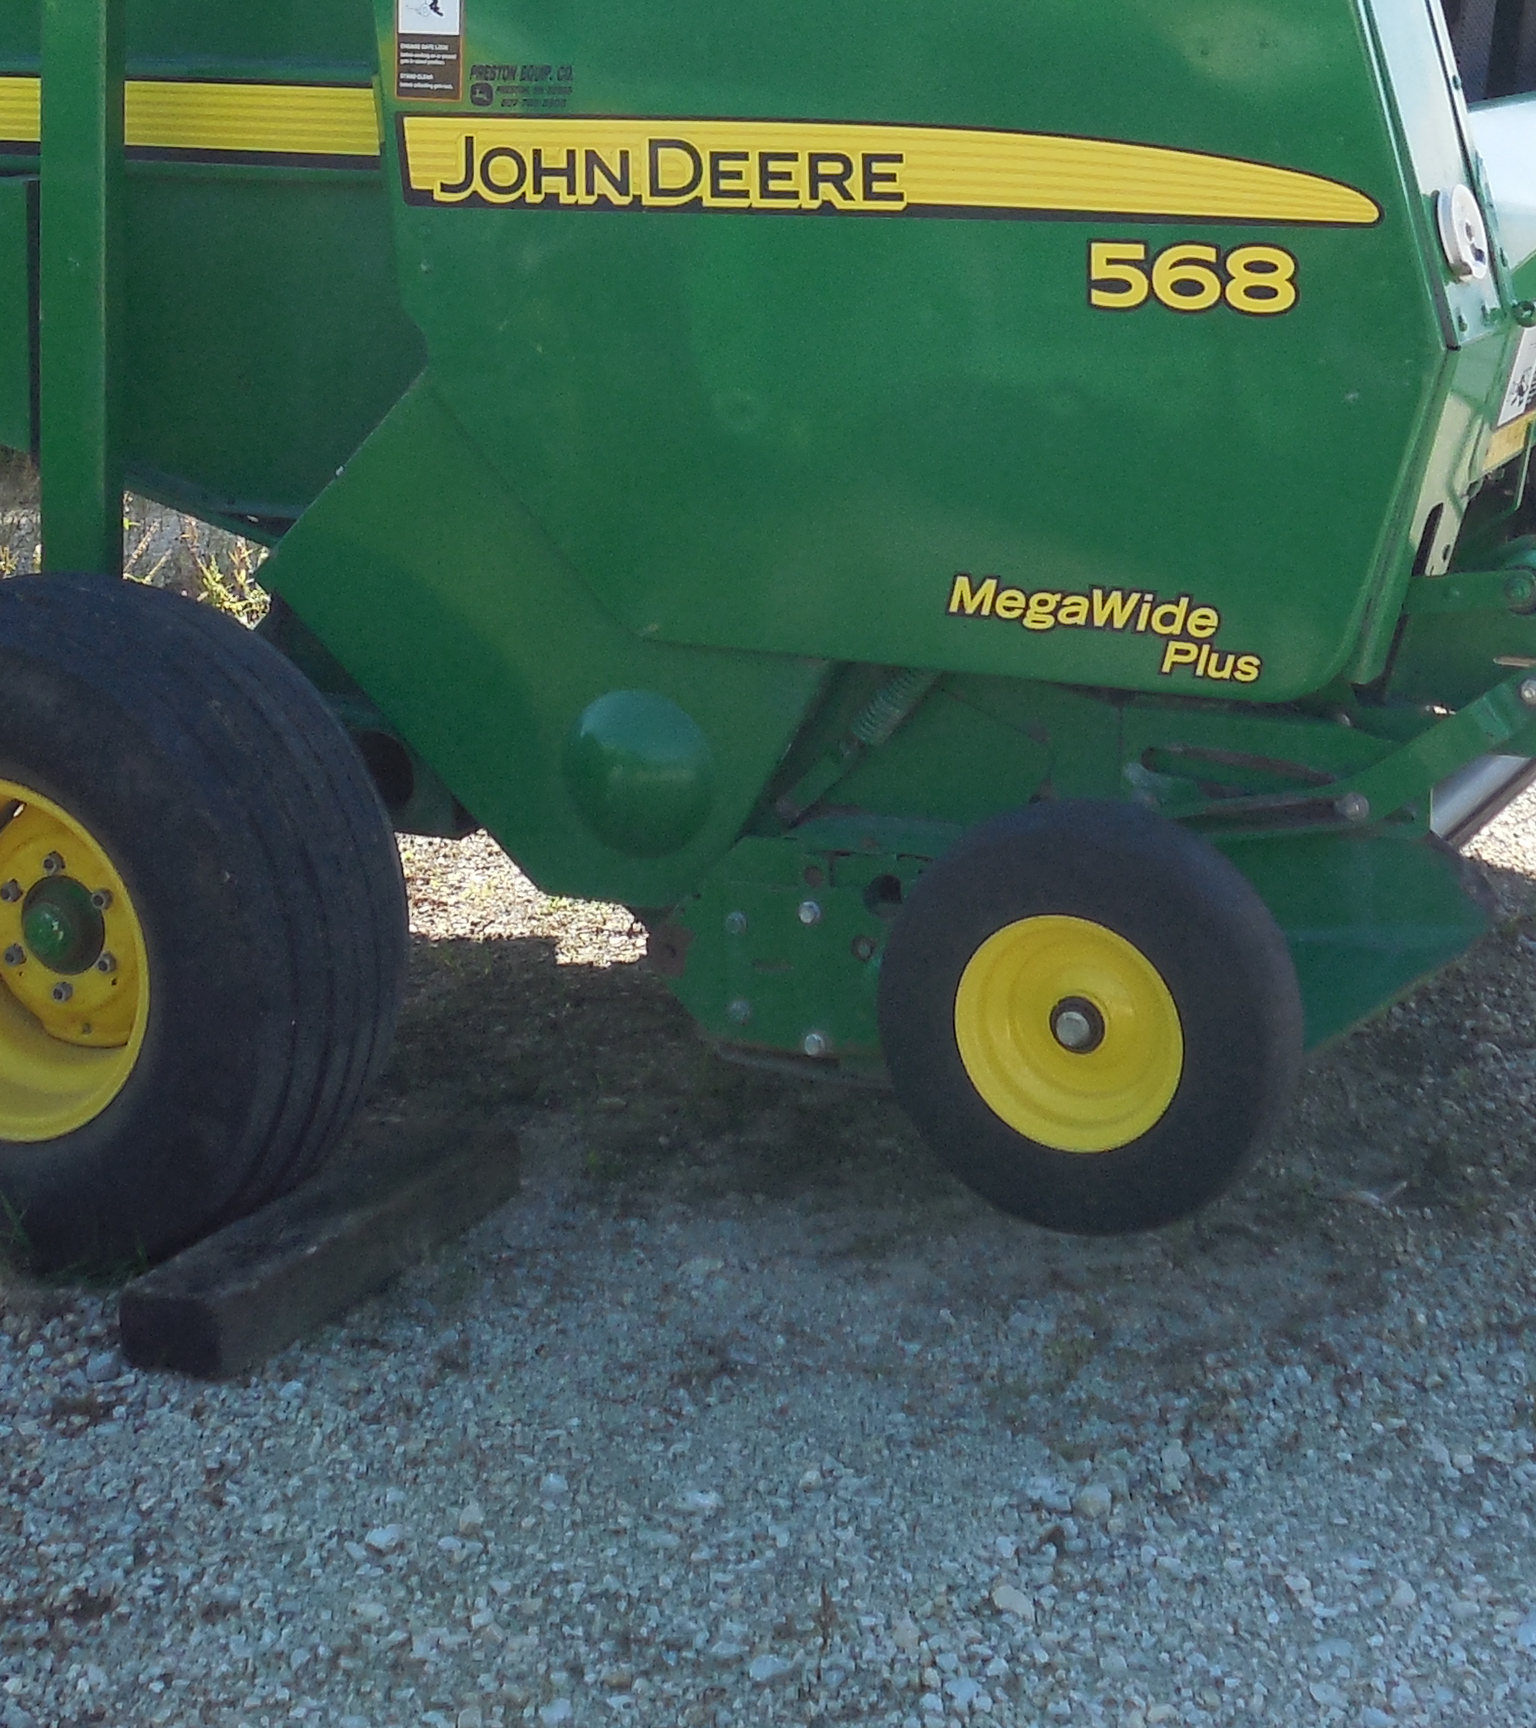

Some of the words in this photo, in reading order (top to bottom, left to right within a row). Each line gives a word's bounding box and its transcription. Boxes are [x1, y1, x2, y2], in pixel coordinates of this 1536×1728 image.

[439, 135, 631, 199] JOHN
[648, 137, 906, 203] DEERE
[1089, 240, 1298, 315] 568
[948, 574, 1221, 639] MegaWide
[1160, 640, 1262, 684] Plus
